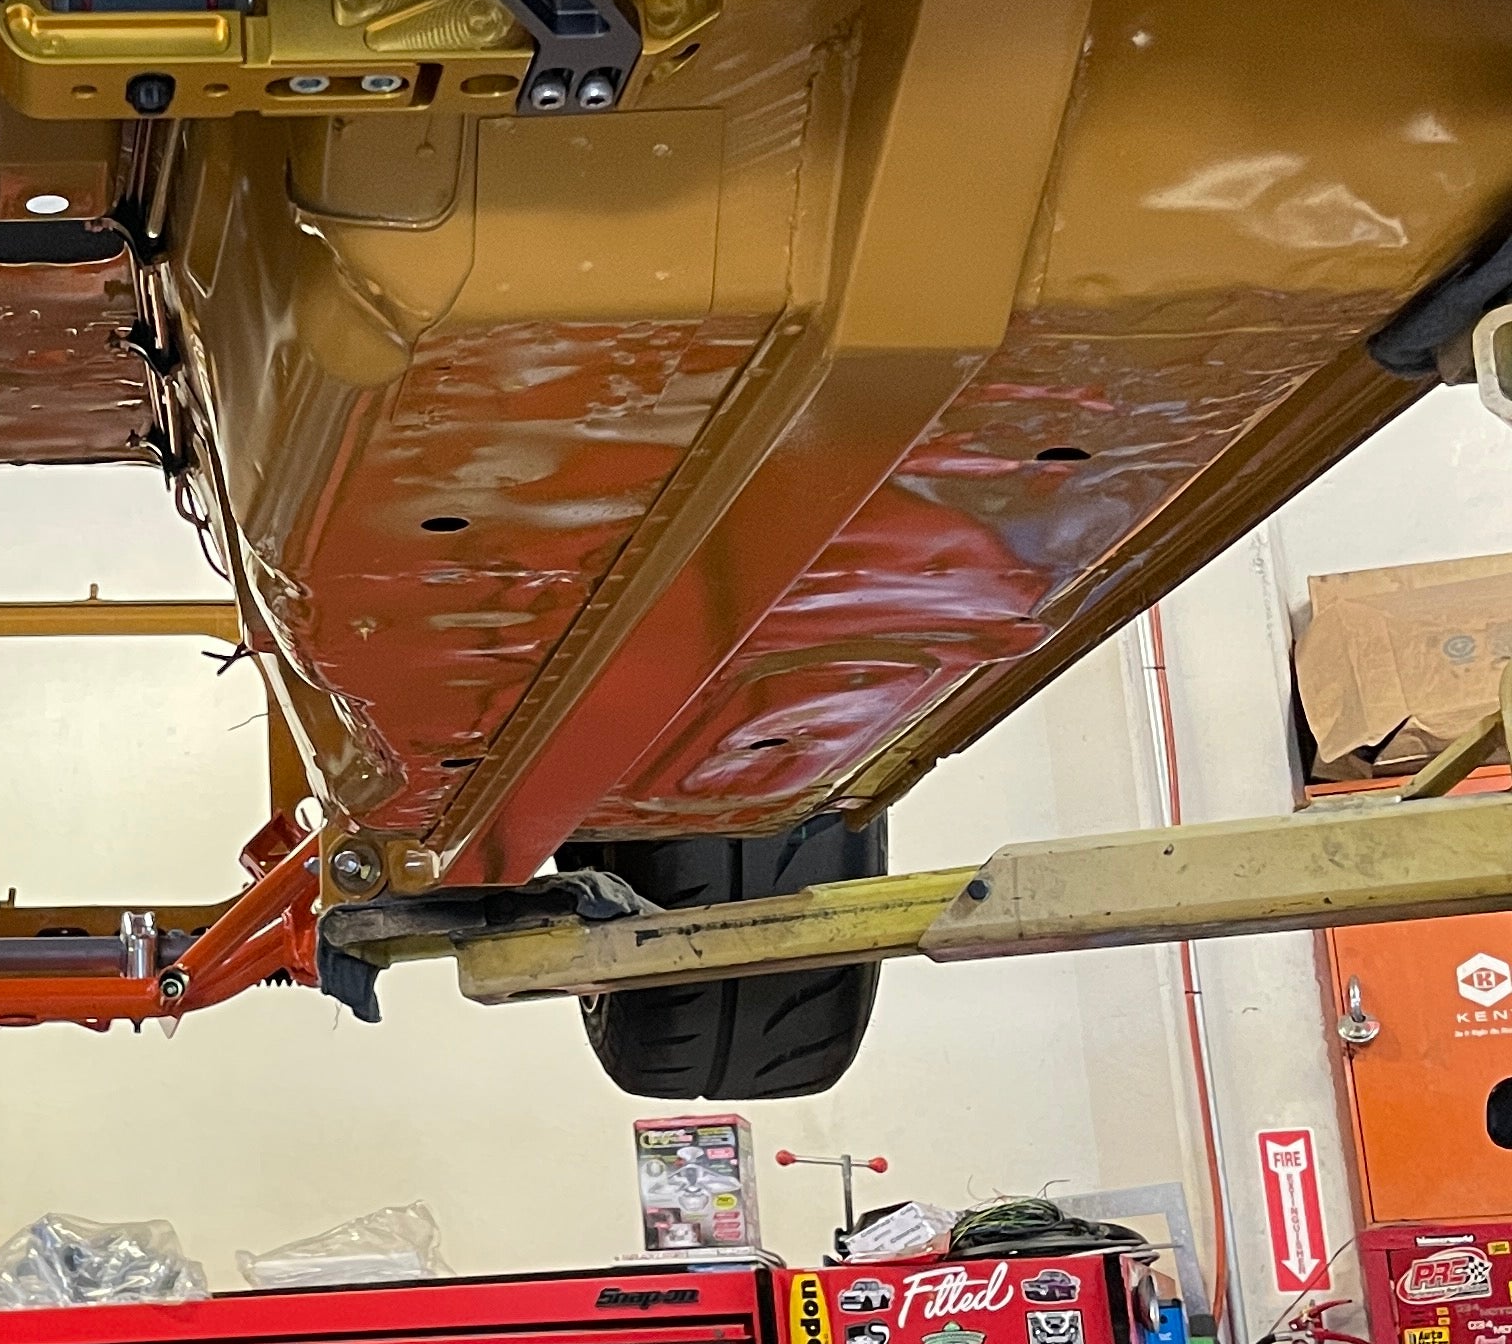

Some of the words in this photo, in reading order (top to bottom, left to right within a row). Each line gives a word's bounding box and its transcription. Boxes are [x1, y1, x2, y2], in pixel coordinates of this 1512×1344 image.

[1455, 1009, 1512, 1023] KEN
[1273, 1151, 1302, 1168] FIRE
[1286, 1173, 1307, 1275] EXTINGUISHER
[595, 1288, 700, 1310] Snap-on
[898, 1261, 1014, 1328] Fitted
[1418, 1330, 1443, 1340] Auto
